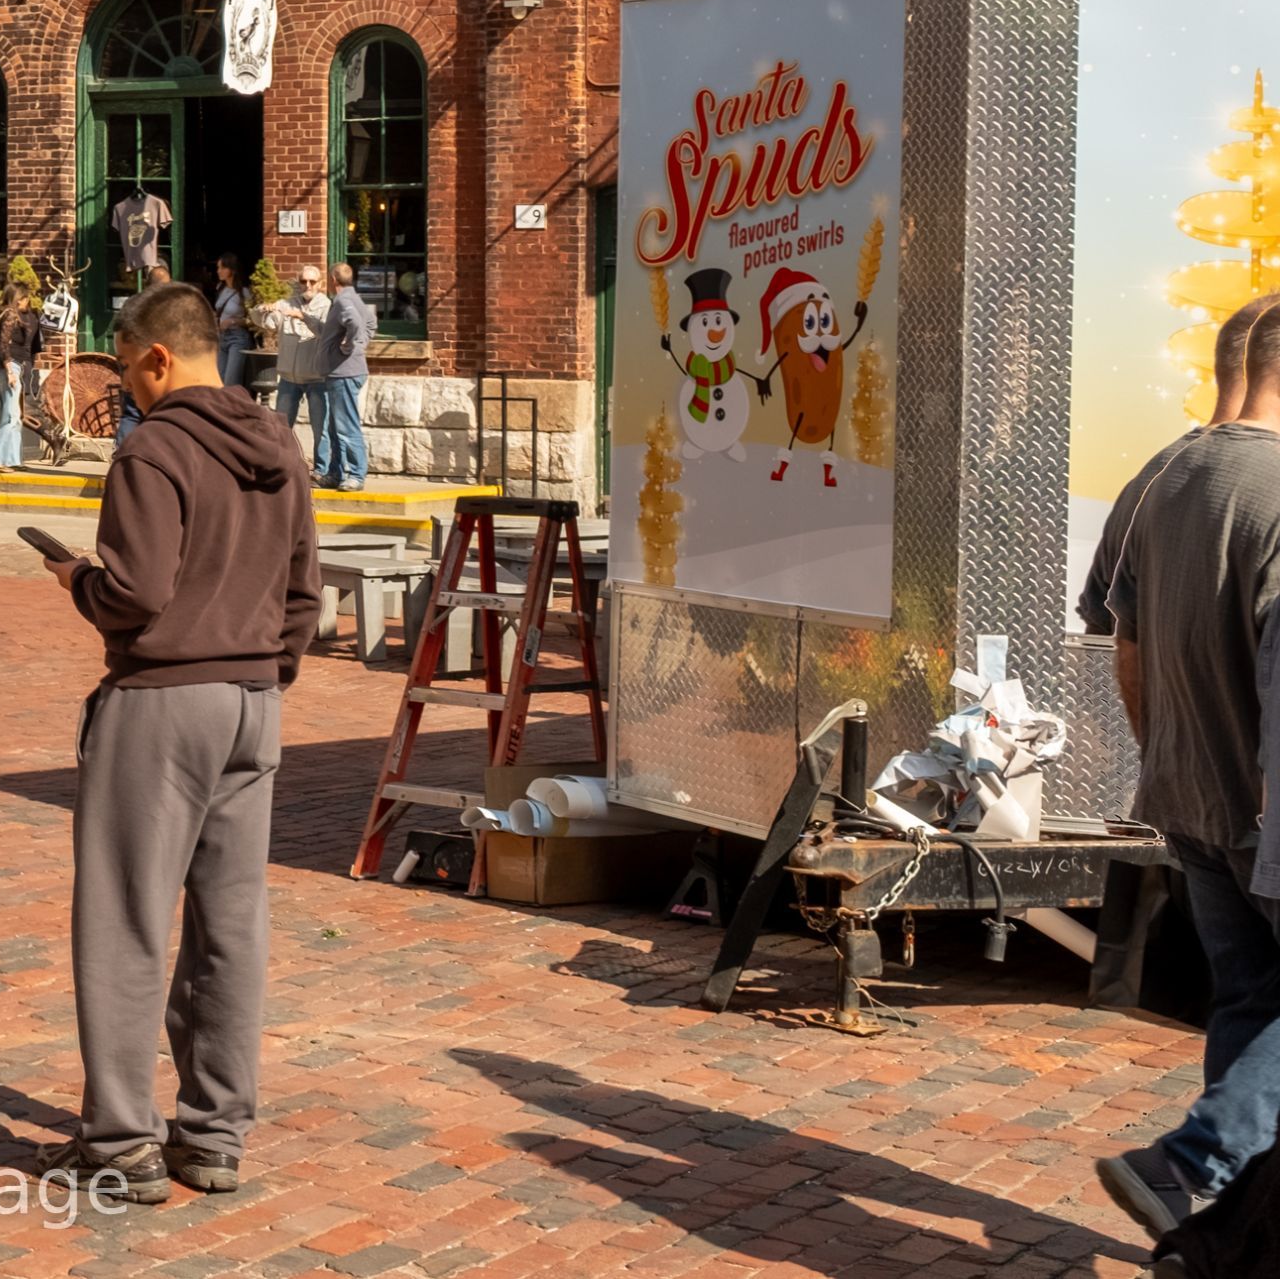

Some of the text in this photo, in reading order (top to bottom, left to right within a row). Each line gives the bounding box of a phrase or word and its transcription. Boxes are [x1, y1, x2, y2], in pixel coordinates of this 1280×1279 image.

[676, 61, 800, 164] Santa
[637, 82, 874, 265] Spuds
[532, 209, 541, 224] 9
[729, 204, 799, 249] flavoured
[743, 220, 844, 278] potato swirls
